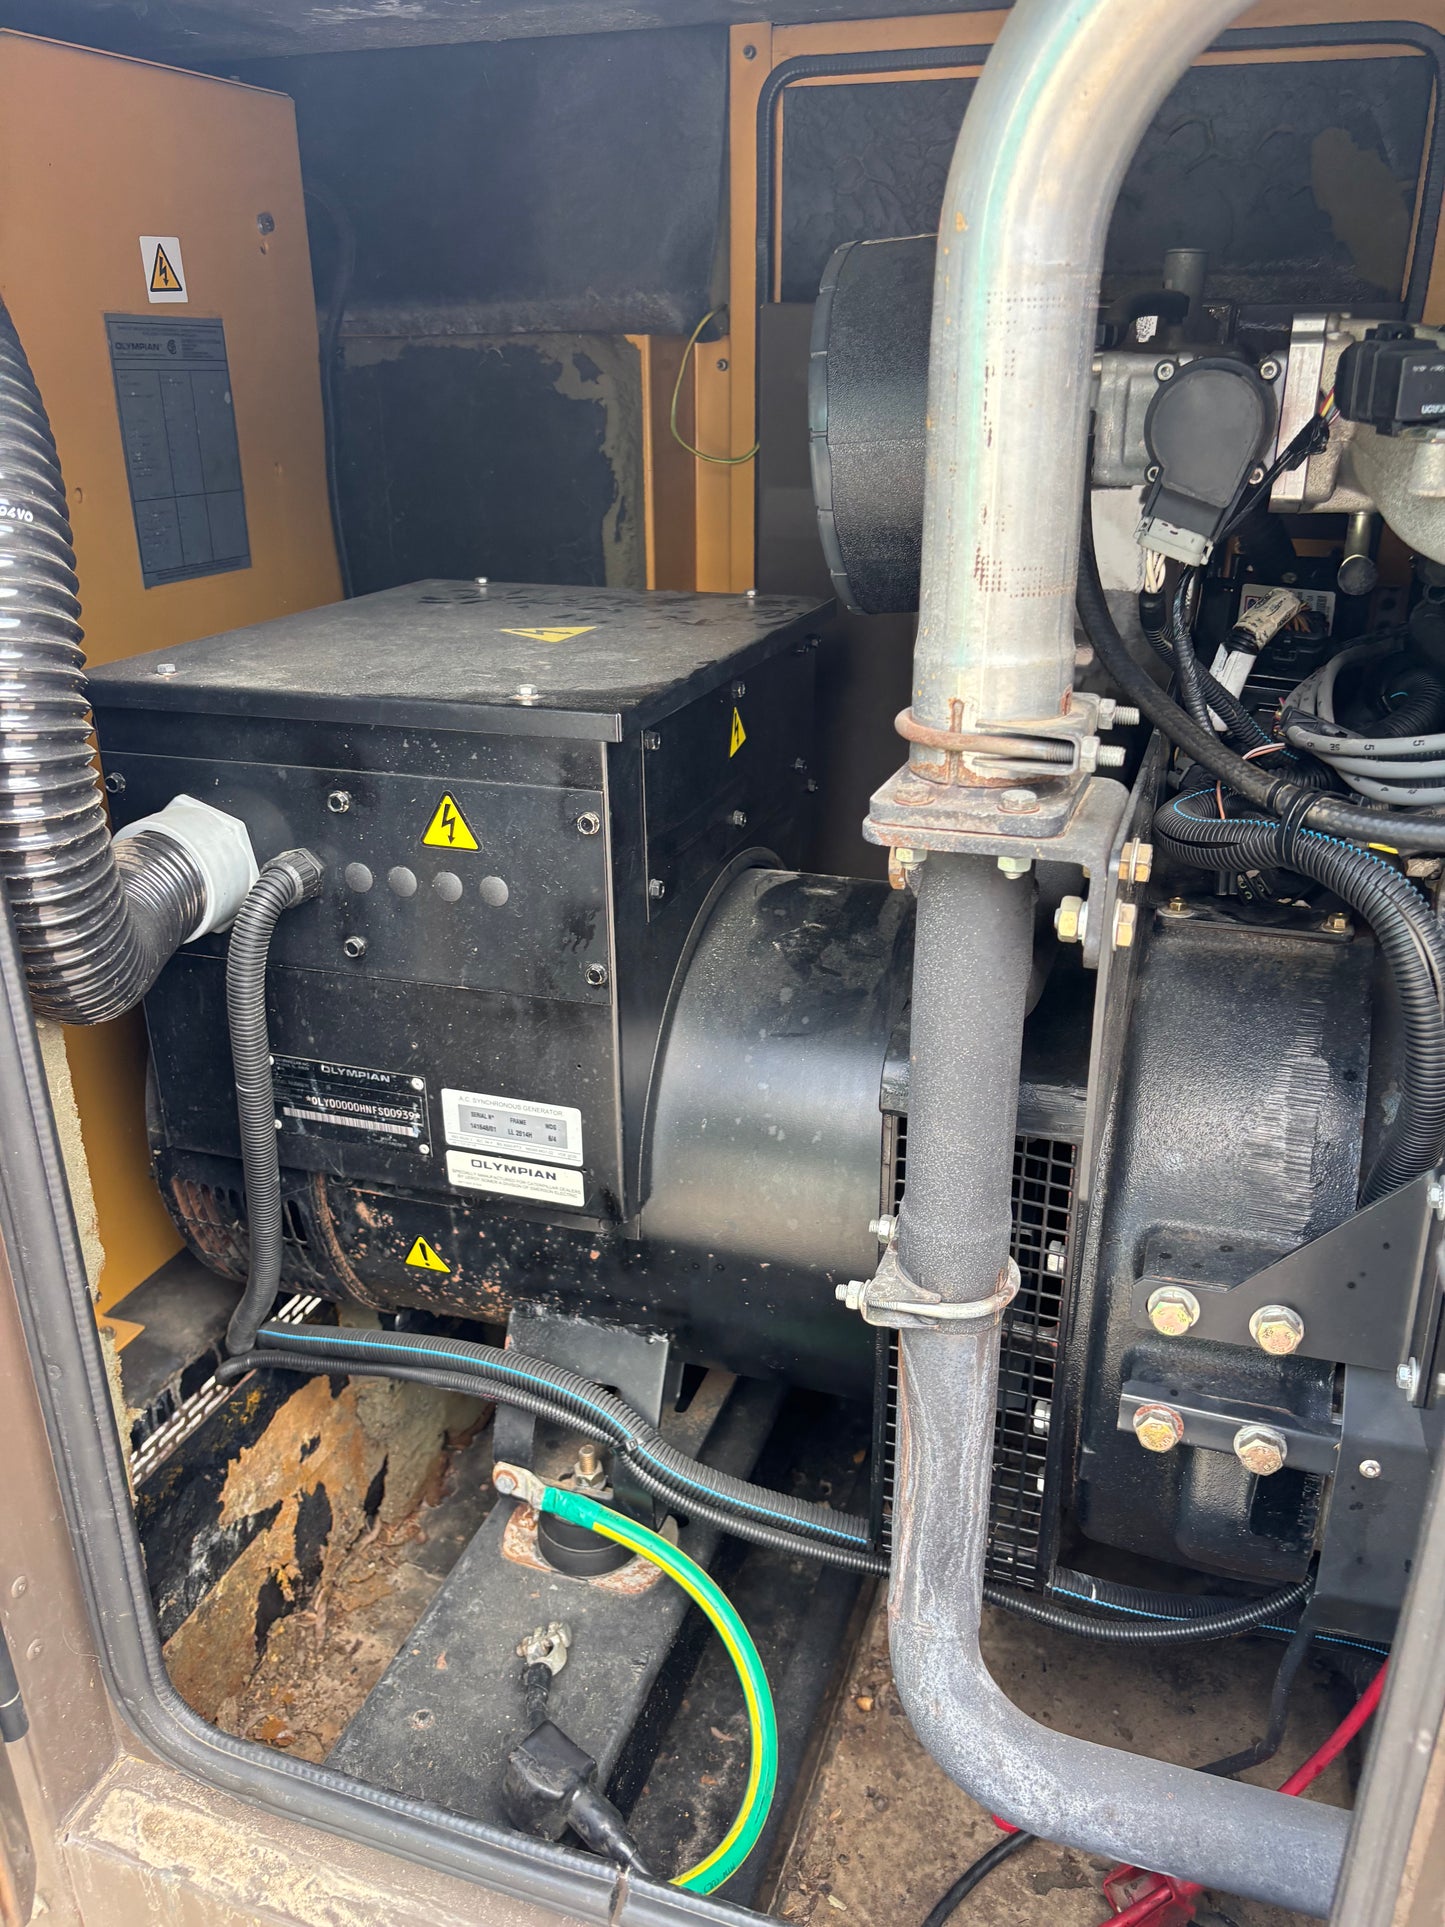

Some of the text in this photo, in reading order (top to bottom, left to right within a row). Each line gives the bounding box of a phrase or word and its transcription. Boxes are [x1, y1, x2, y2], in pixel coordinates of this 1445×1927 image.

[114, 342, 159, 350] OLYMPIAN
[320, 1065, 390, 1082] OLYMPIAN
[472, 1097, 521, 1110] SYNCHRONOUS
[522, 1105, 562, 1116] GENERATOR
[509, 1117, 526, 1125] FRAME
[471, 1159, 556, 1180] OLYMPIAN
[527, 1181, 557, 1190] CATERPILLAR
[559, 1186, 580, 1194] DEALERS
